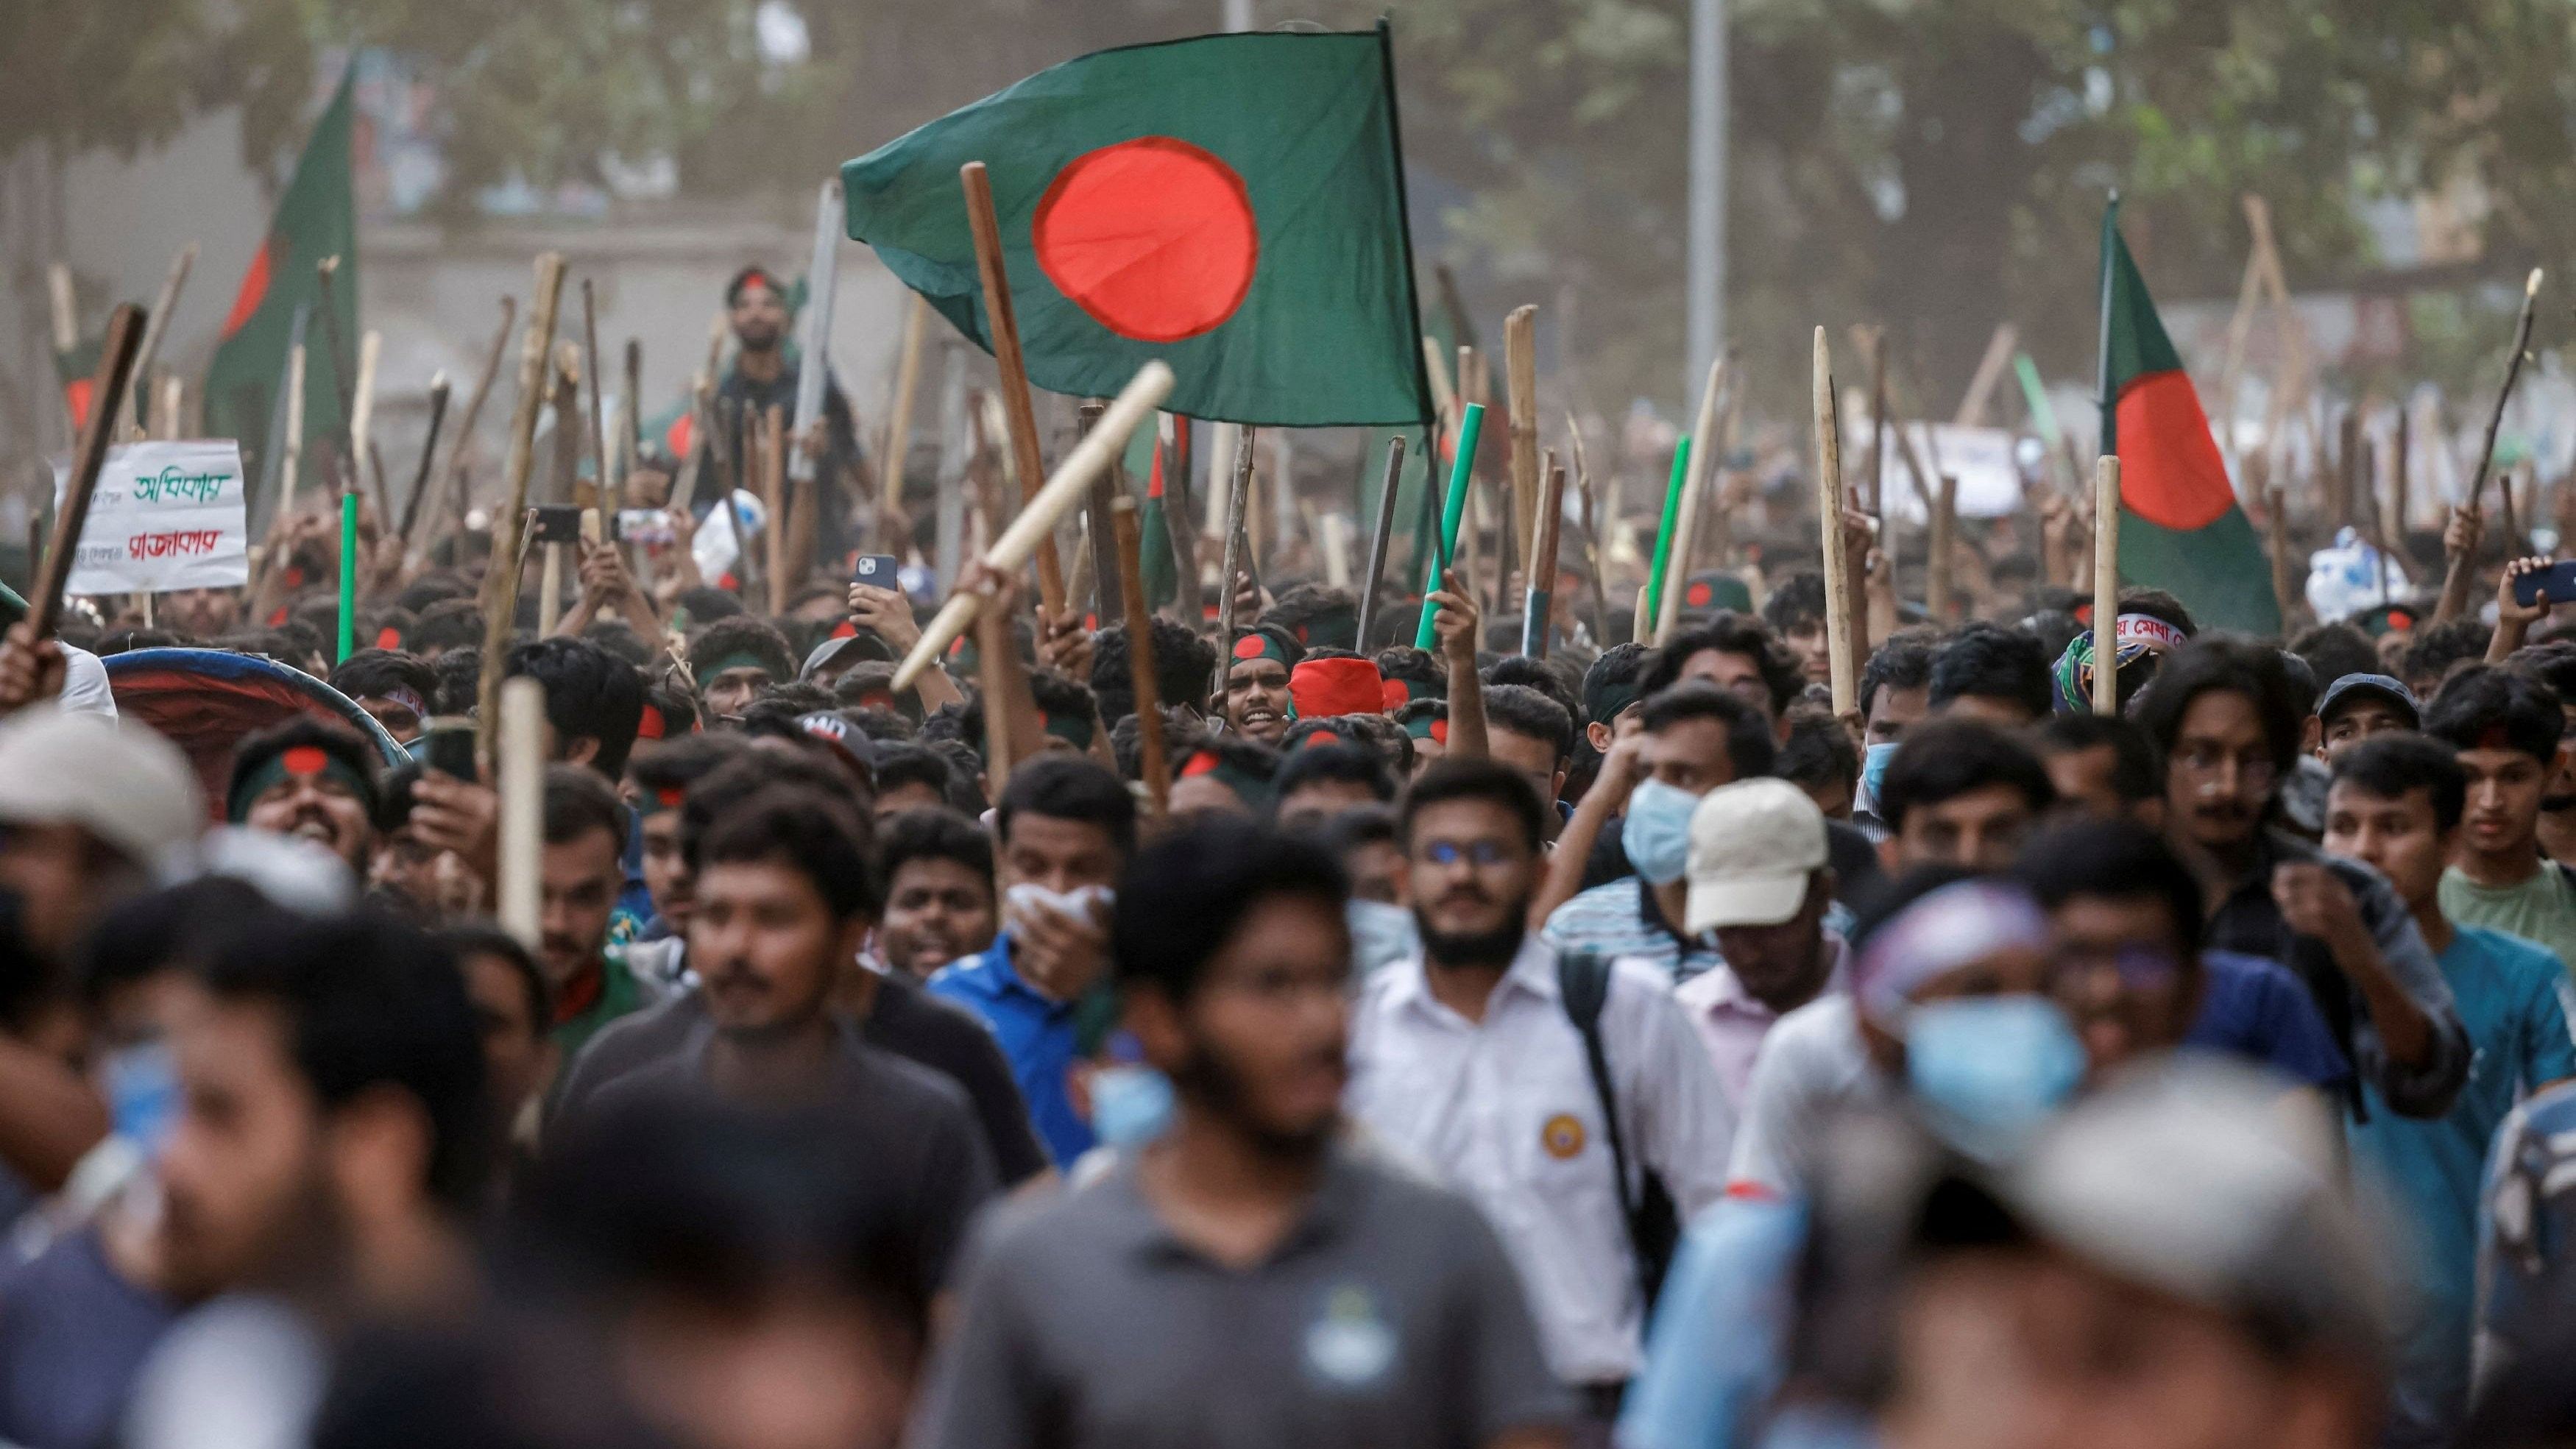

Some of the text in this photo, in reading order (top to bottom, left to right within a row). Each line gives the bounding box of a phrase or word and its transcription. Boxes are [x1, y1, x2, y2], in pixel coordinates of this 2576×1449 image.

[133, 464, 233, 503] অধিকার
[130, 529, 224, 561] রাজাকার
[2134, 619, 2170, 642] মেধা
